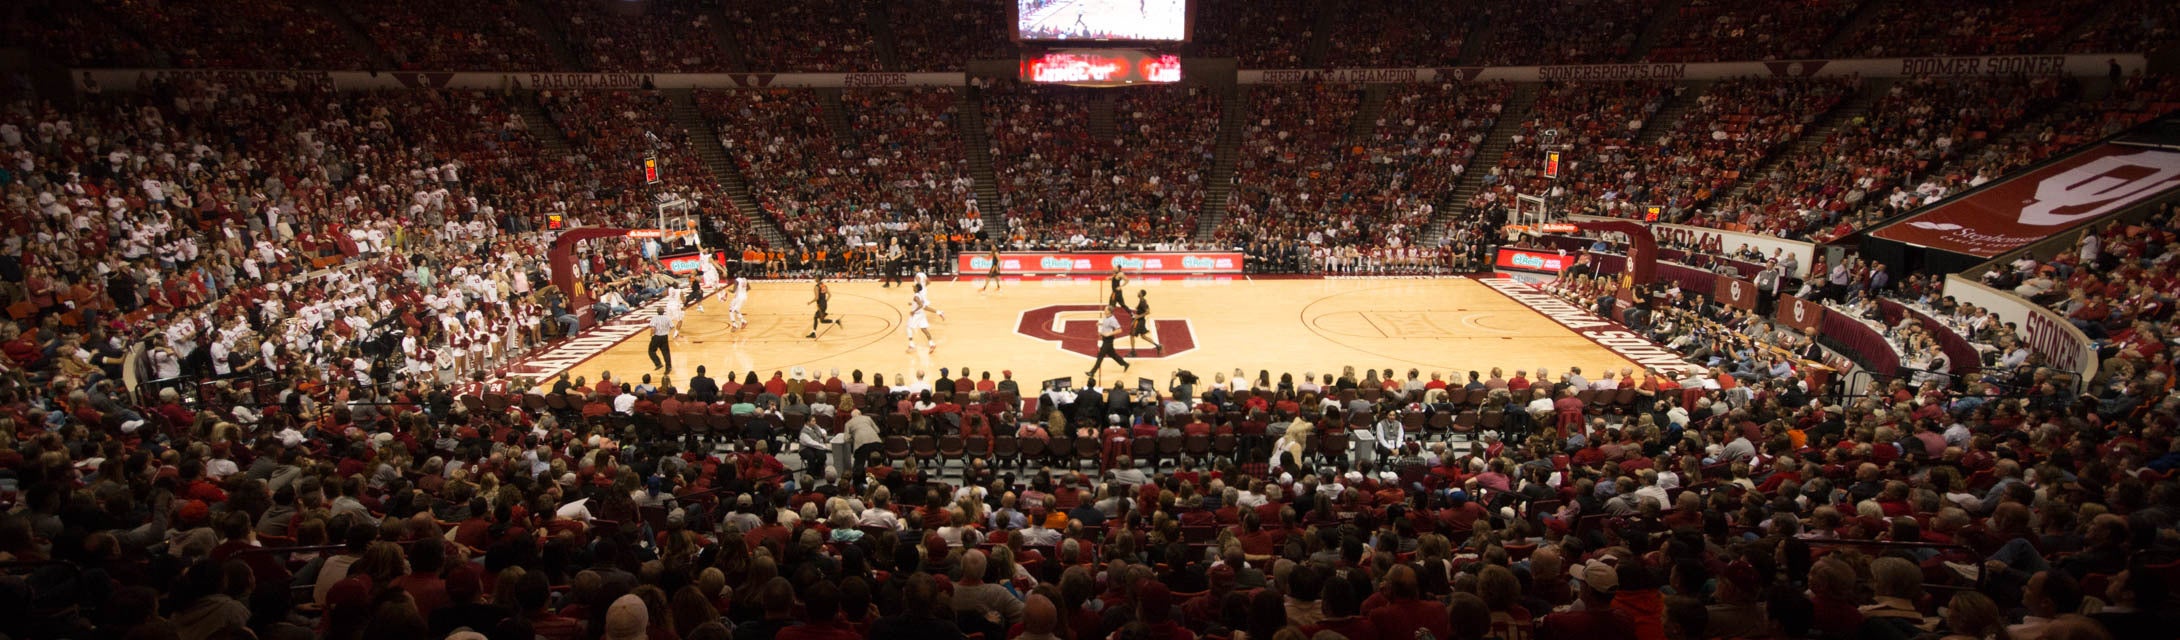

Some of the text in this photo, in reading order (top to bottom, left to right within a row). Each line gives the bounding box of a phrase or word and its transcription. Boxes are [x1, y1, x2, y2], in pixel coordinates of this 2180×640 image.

[1538, 64, 1686, 80] SOONERSPORTS.COM
[1900, 56, 2064, 76] BOOMER SOONER
[531, 74, 563, 88] RAH
[845, 73, 907, 86] #SOONERS
[1262, 71, 1301, 83] CHEER
[1351, 70, 1417, 82] CHAMPION
[2022, 310, 2081, 372] SOONERS
[506, 322, 653, 384] LAHOMA
[490, 383, 503, 392] 24
